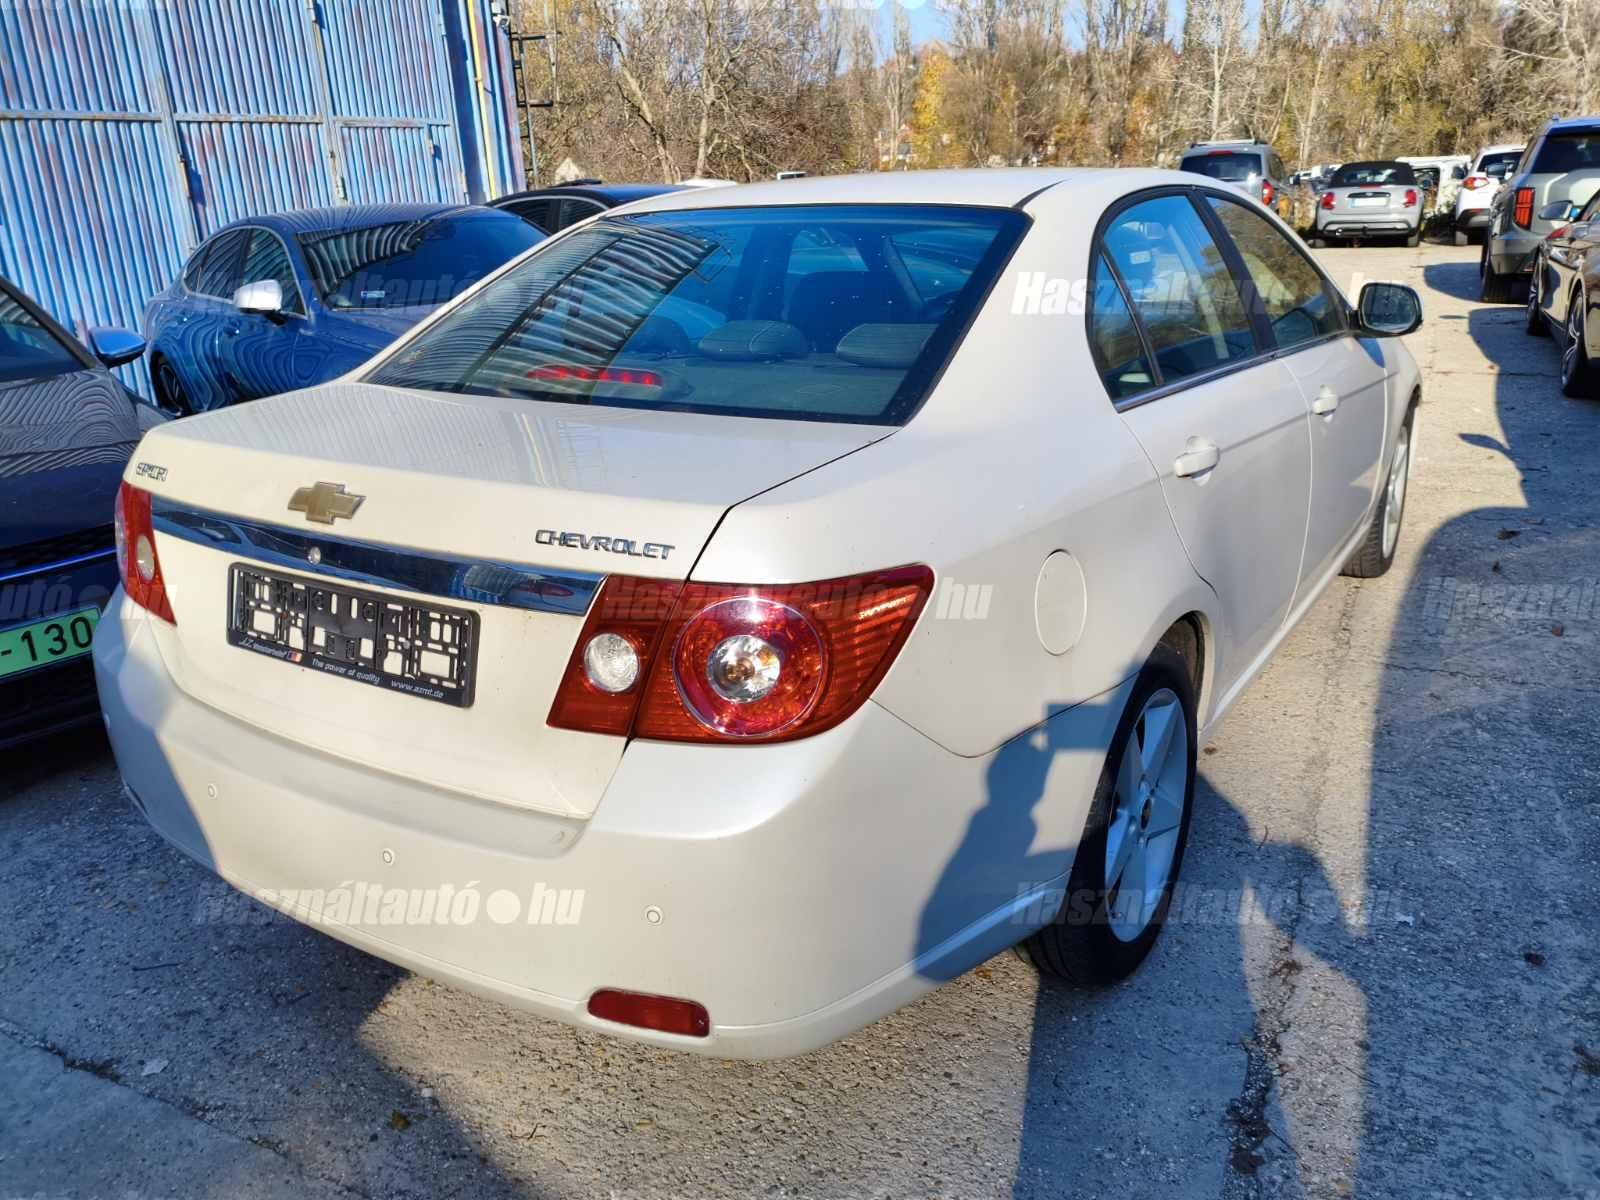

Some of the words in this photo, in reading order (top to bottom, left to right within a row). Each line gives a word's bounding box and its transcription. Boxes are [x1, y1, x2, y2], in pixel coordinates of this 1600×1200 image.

[535, 529, 676, 560] CHEVROLET
[311, 658, 324, 669] The
[324, 663, 347, 675] power
[347, 668, 356, 677] of
[356, 670, 381, 685] quality
